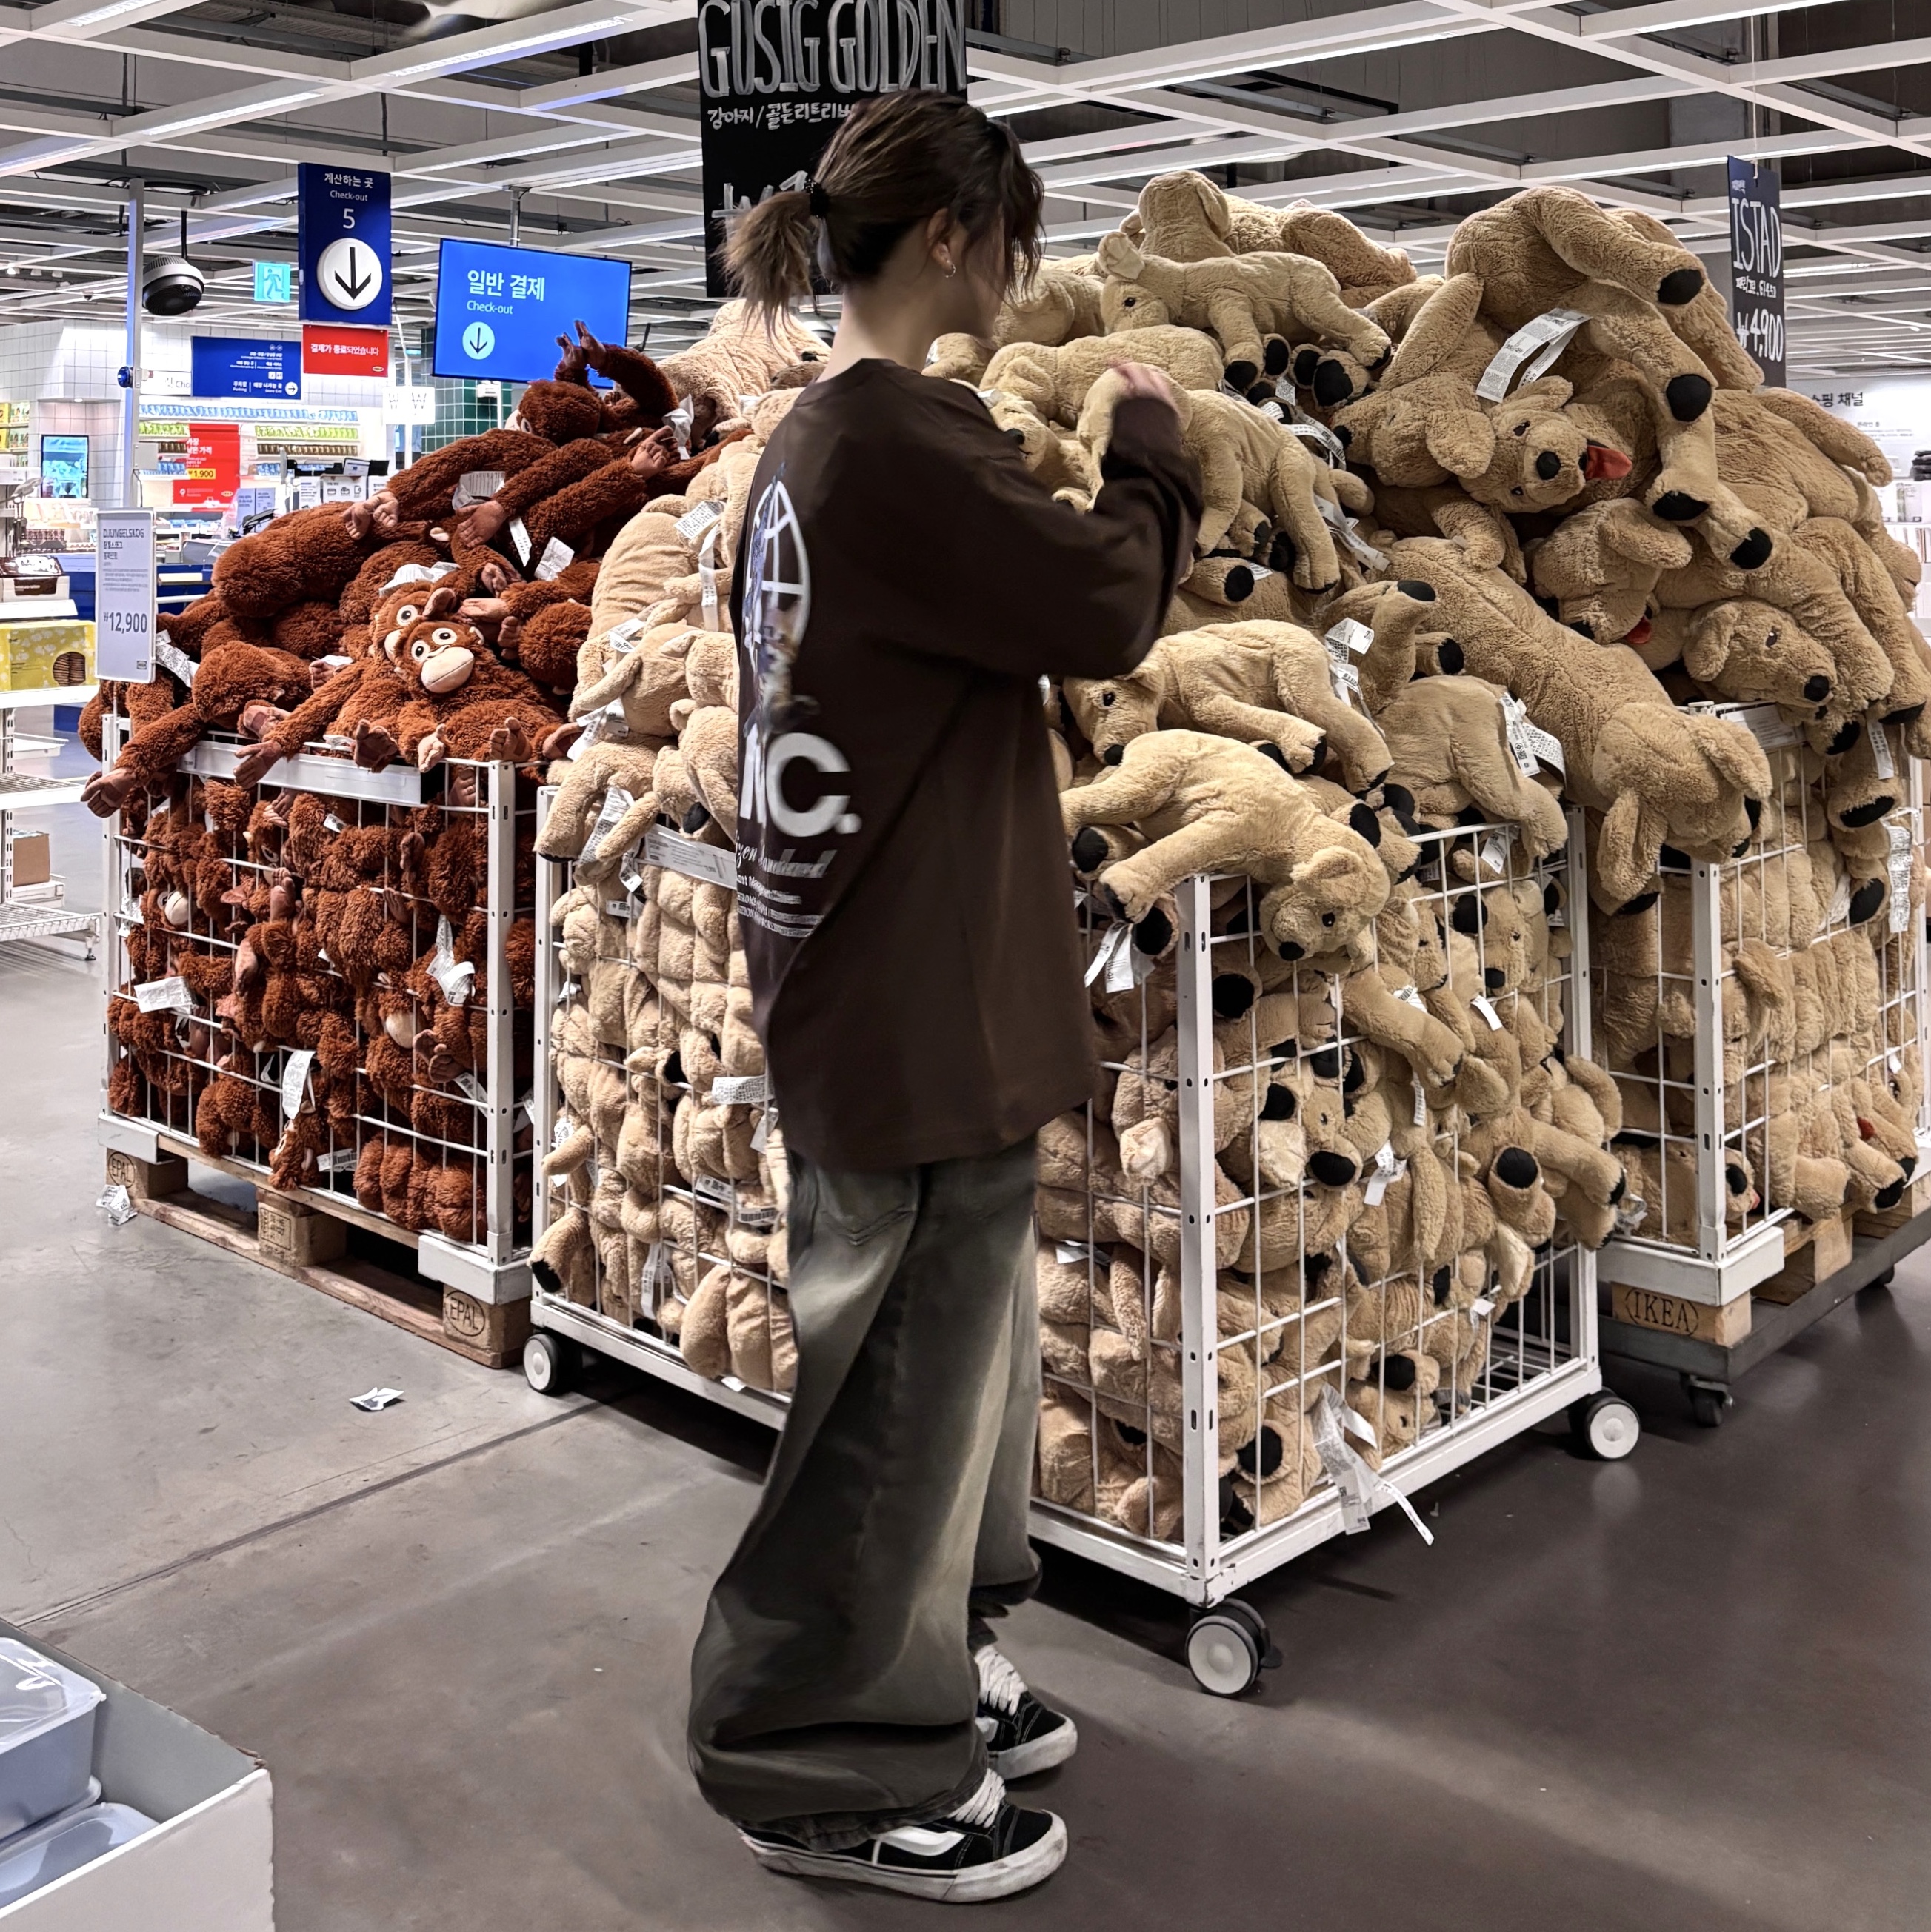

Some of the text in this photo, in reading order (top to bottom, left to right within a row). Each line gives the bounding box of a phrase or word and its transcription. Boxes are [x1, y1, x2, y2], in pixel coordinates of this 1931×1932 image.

[827, 0, 967, 93] GOLDEN
[324, 173, 373, 189] 계산하는 곳
[330, 190, 368, 201] Check-out
[343, 208, 356, 229] 5
[1731, 198, 1781, 278] ISTAD
[467, 270, 545, 301] 일반 결제
[466, 300, 513, 315] Check-out
[1736, 308, 1784, 362] ₩4,900
[1838, 392, 1864, 407] 채널
[103, 612, 147, 635] ₩12,900
[112, 1157, 132, 1183] EPAL
[450, 1297, 479, 1331] EPAL
[1634, 1291, 1690, 1332] IKEA
